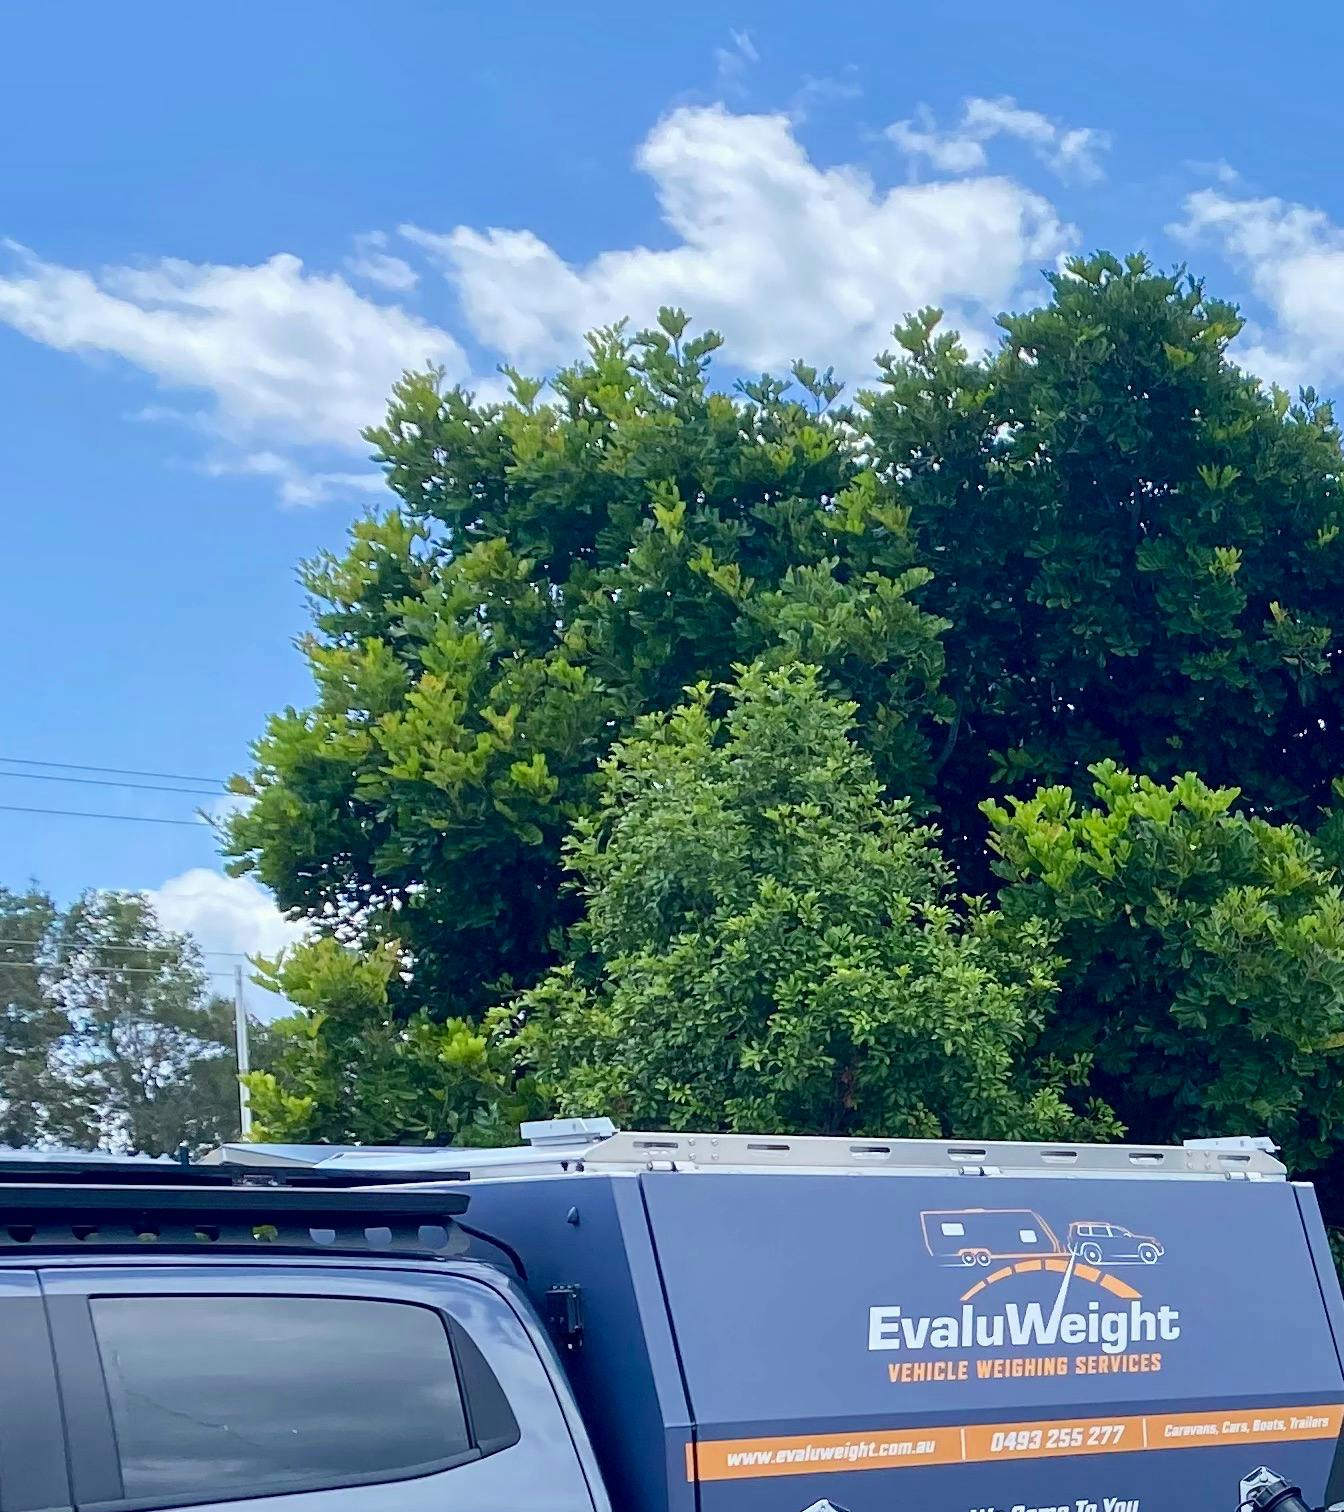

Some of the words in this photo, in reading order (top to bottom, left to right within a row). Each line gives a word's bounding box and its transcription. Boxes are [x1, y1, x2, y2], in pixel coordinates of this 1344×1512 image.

[868, 1300, 1181, 1353] EvaluWeight
[887, 1360, 968, 1383] VEHICLE
[976, 1357, 1068, 1379] WEIGHING
[1075, 1352, 1162, 1375] SERVICES
[990, 1429, 1041, 1452] 0493
[1045, 1427, 1083, 1449] 255
[1087, 1425, 1126, 1446] 277
[1164, 1424, 1219, 1438] Caravans,
[1222, 1421, 1250, 1435] Cars,
[1253, 1419, 1287, 1433] Boats,
[1290, 1415, 1330, 1430] Trailers
[727, 1439, 936, 1467] www.evaluweight.com.au
